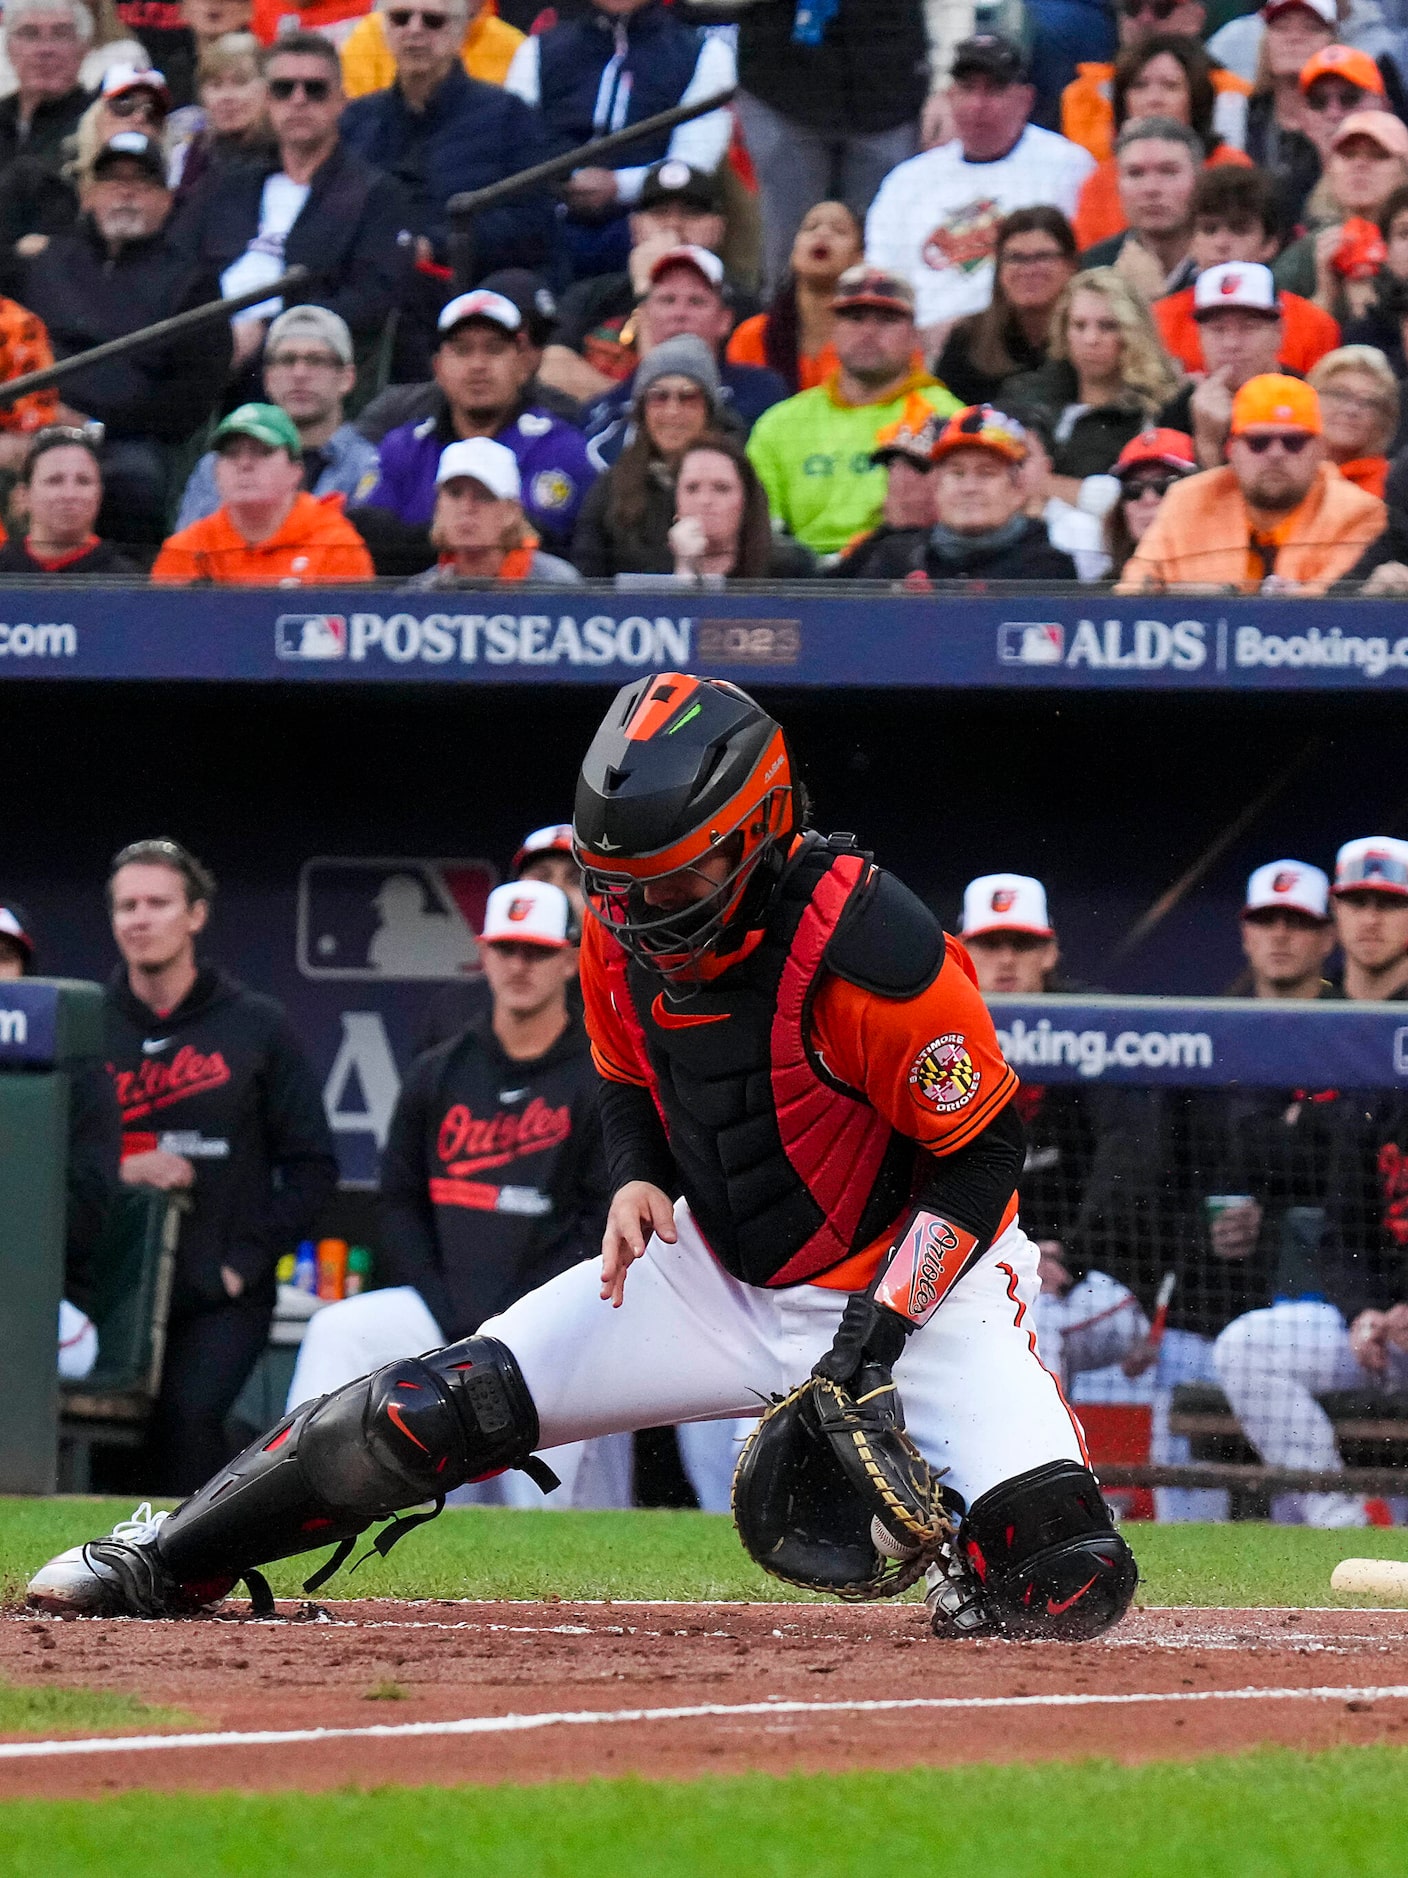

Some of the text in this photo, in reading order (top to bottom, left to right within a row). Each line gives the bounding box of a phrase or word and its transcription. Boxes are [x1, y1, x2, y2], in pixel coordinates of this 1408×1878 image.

[350, 613, 800, 665] POSTSEASON 2023
[1066, 619, 1206, 669] ALDS
[909, 1034, 965, 1084] BALTIMORE
[936, 1071, 980, 1112] ORIOLES
[437, 1096, 573, 1173] Orioles
[909, 1219, 960, 1316] Orioles
